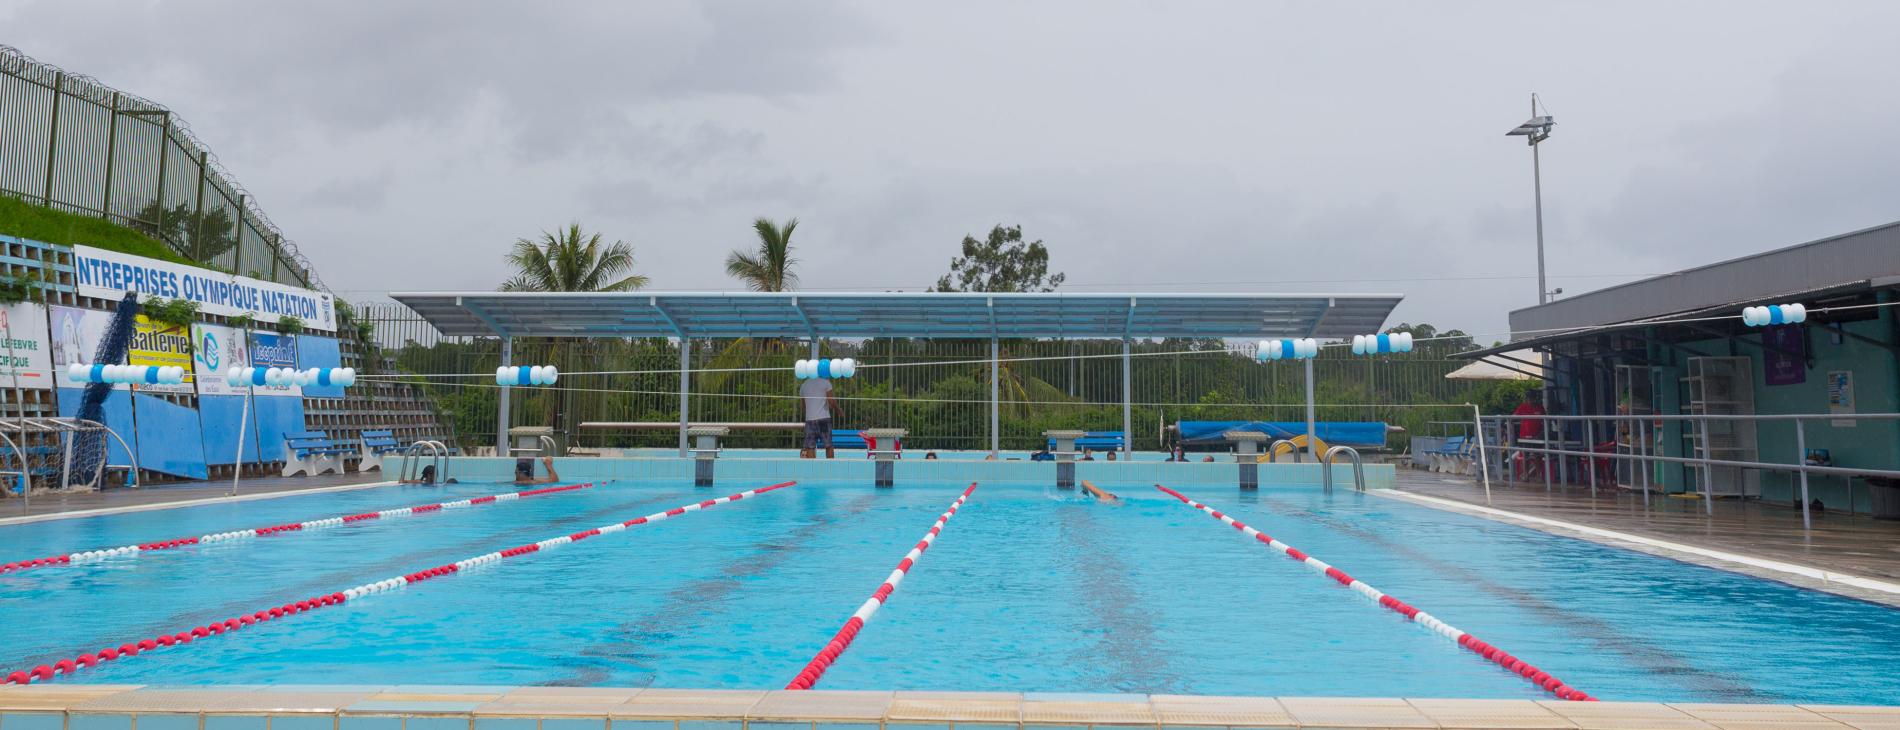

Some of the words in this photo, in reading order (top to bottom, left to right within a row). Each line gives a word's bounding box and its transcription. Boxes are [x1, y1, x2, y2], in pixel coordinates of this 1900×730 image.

[77, 256, 179, 299] NTREPRISES
[183, 273, 260, 312] OLYMPIQUE
[261, 289, 318, 320] NATATION
[129, 327, 189, 354] Batterie
[0, 355, 30, 367] CIFQUE
